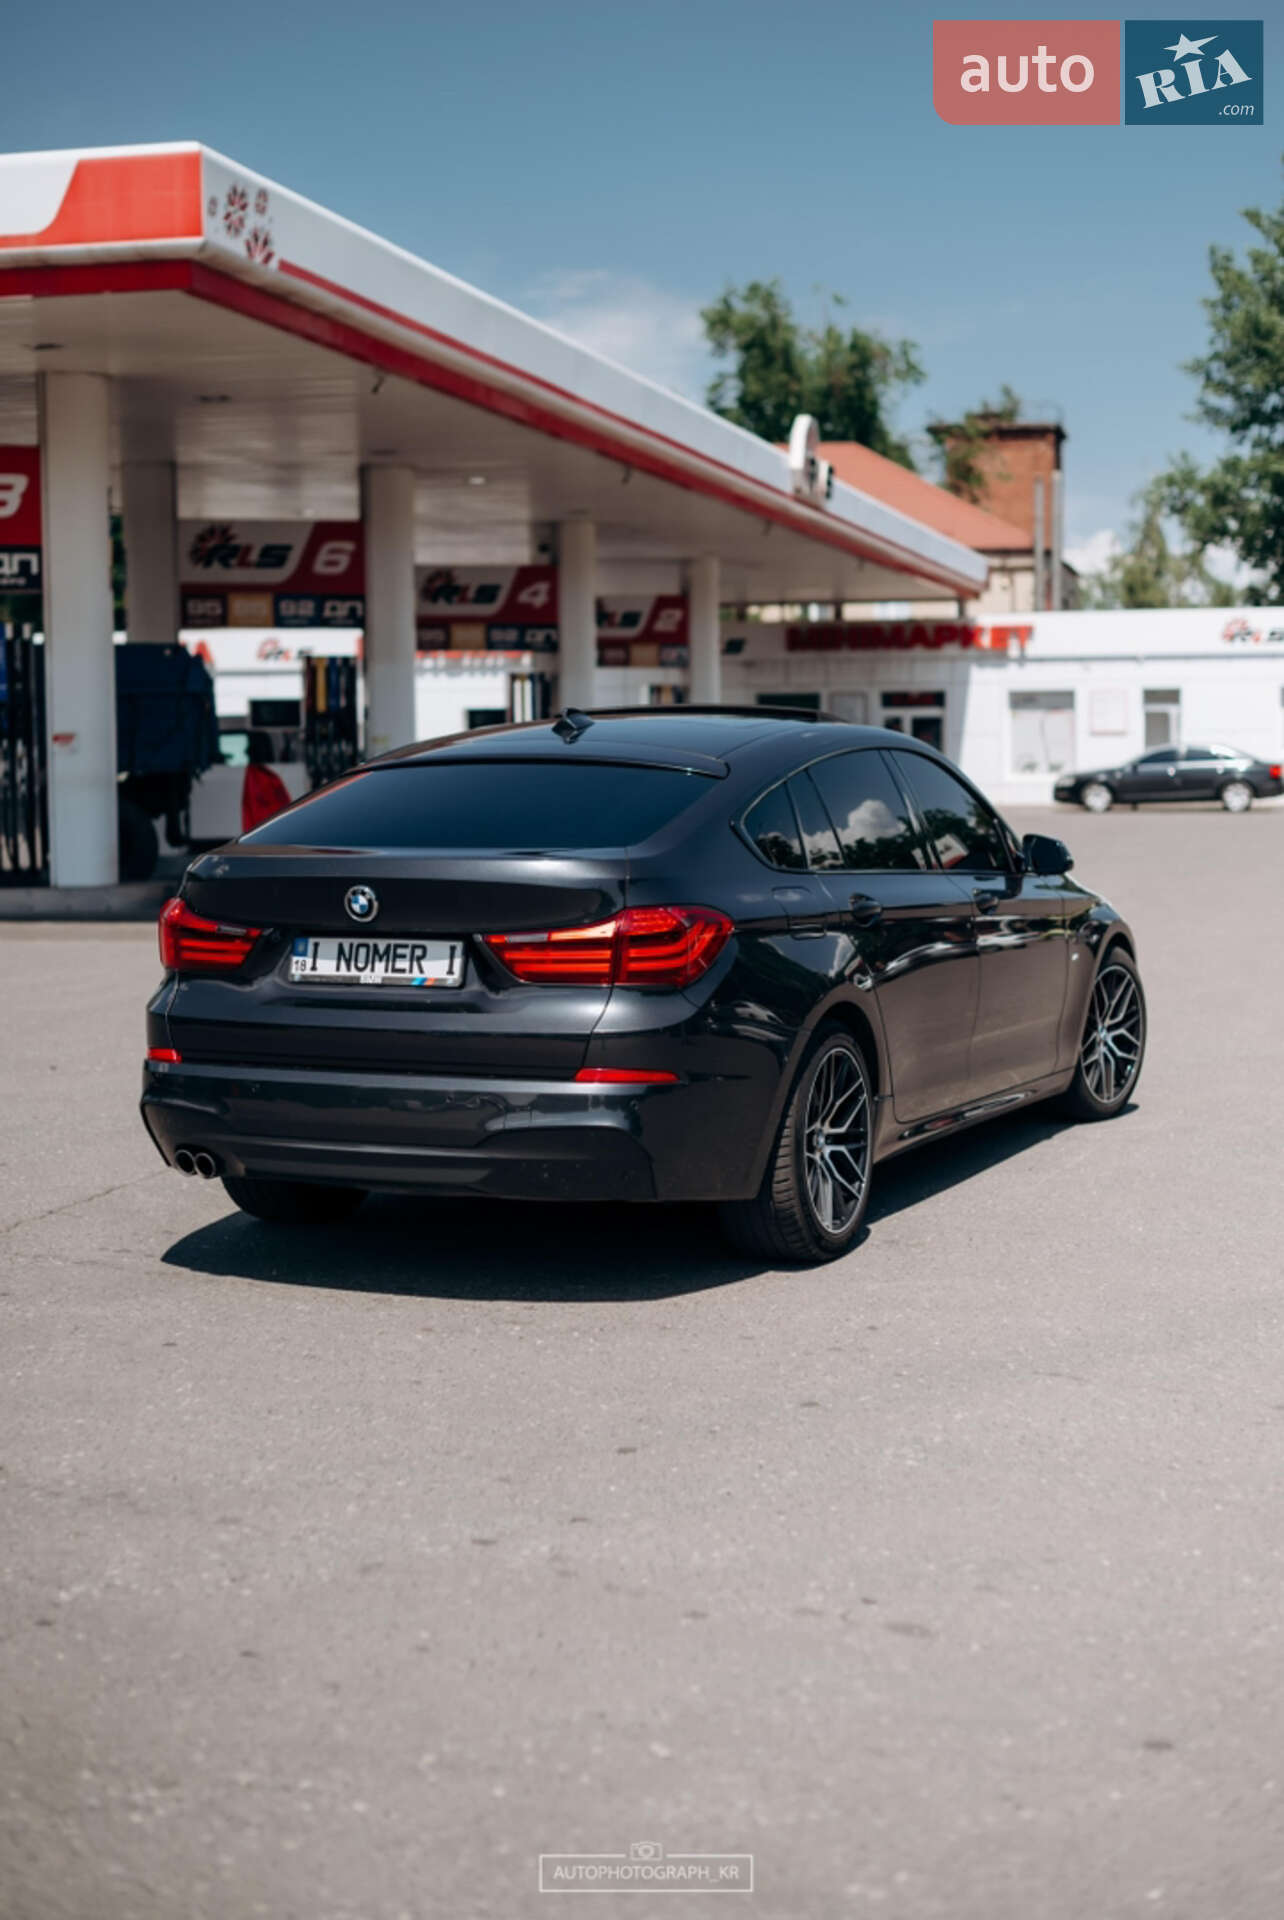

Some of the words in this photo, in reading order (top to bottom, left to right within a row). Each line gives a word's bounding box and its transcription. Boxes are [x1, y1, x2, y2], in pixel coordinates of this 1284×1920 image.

[313, 541, 356, 575] 6
[517, 581, 551, 608] 4
[336, 942, 427, 974] NOMER
